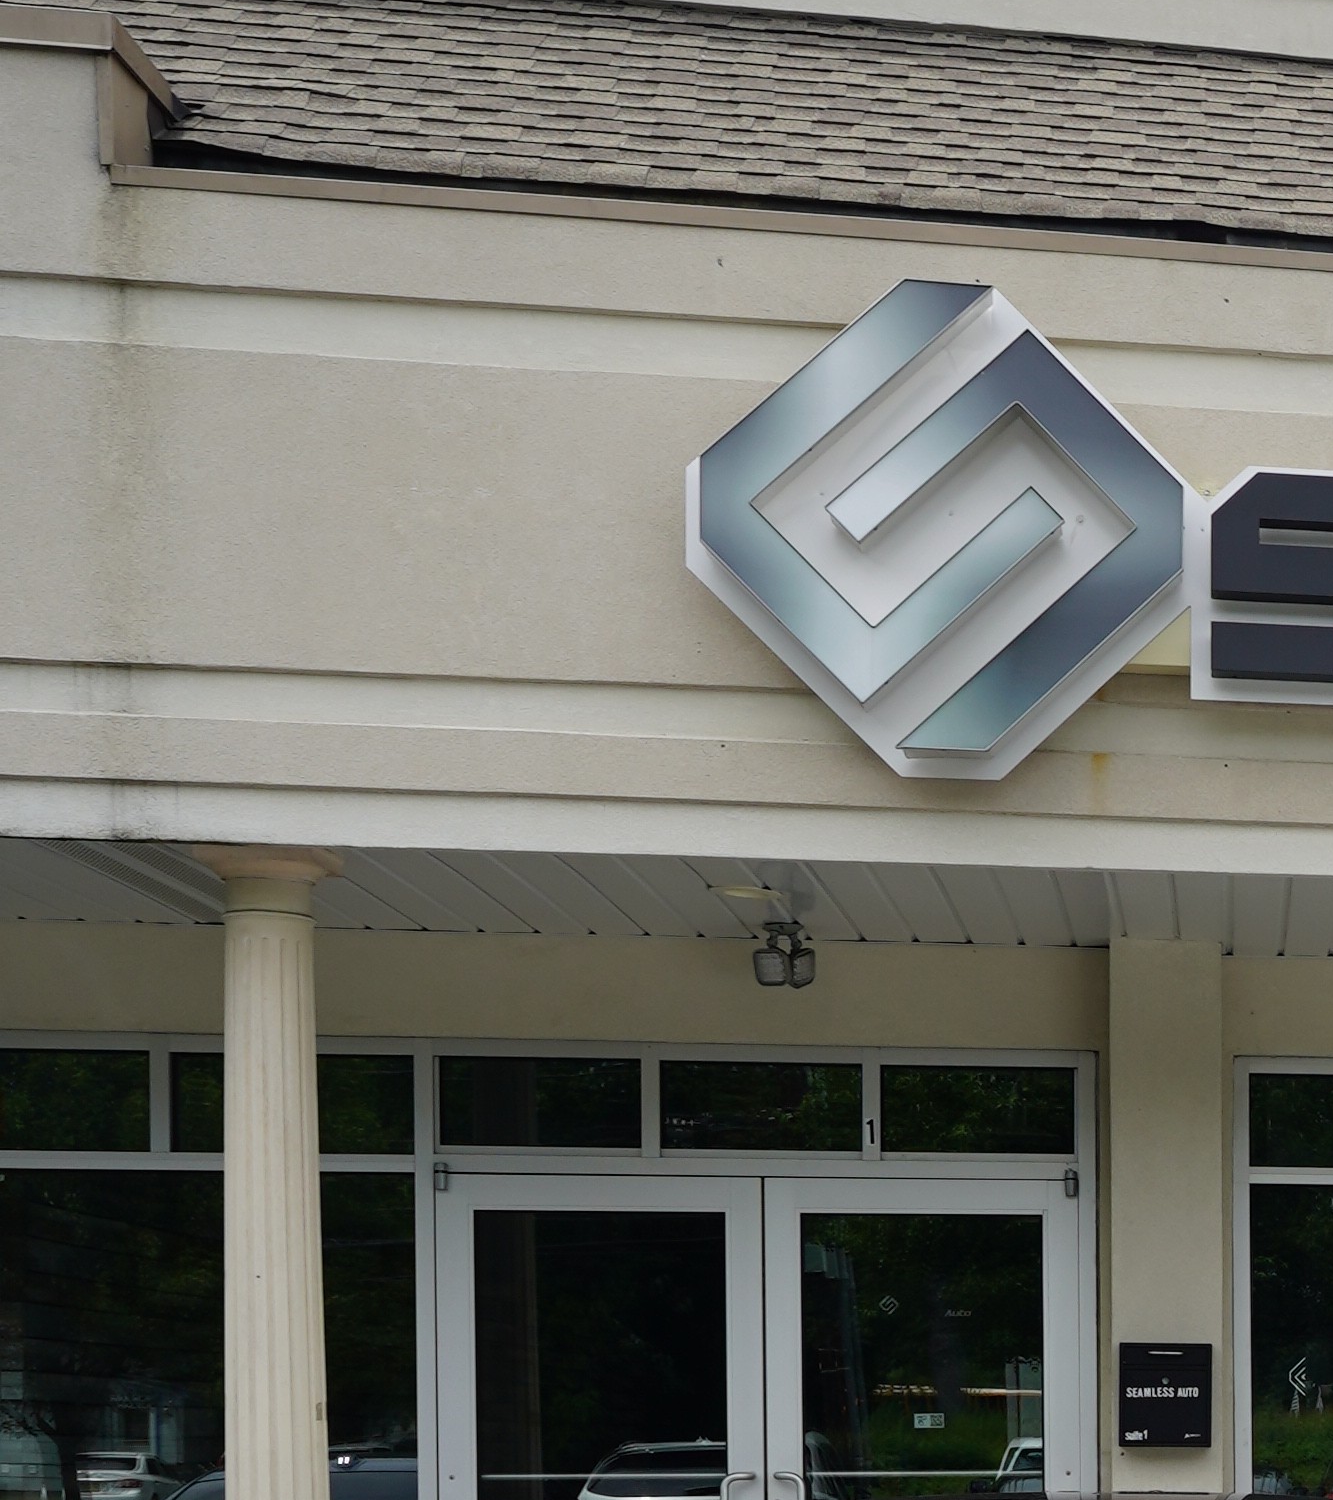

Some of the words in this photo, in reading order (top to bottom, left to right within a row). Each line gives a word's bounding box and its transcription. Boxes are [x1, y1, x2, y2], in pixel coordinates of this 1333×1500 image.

[866, 1118, 875, 1145] 1
[1125, 1387, 1175, 1398] SEAMLESS
[1177, 1387, 1199, 1398] AUTO
